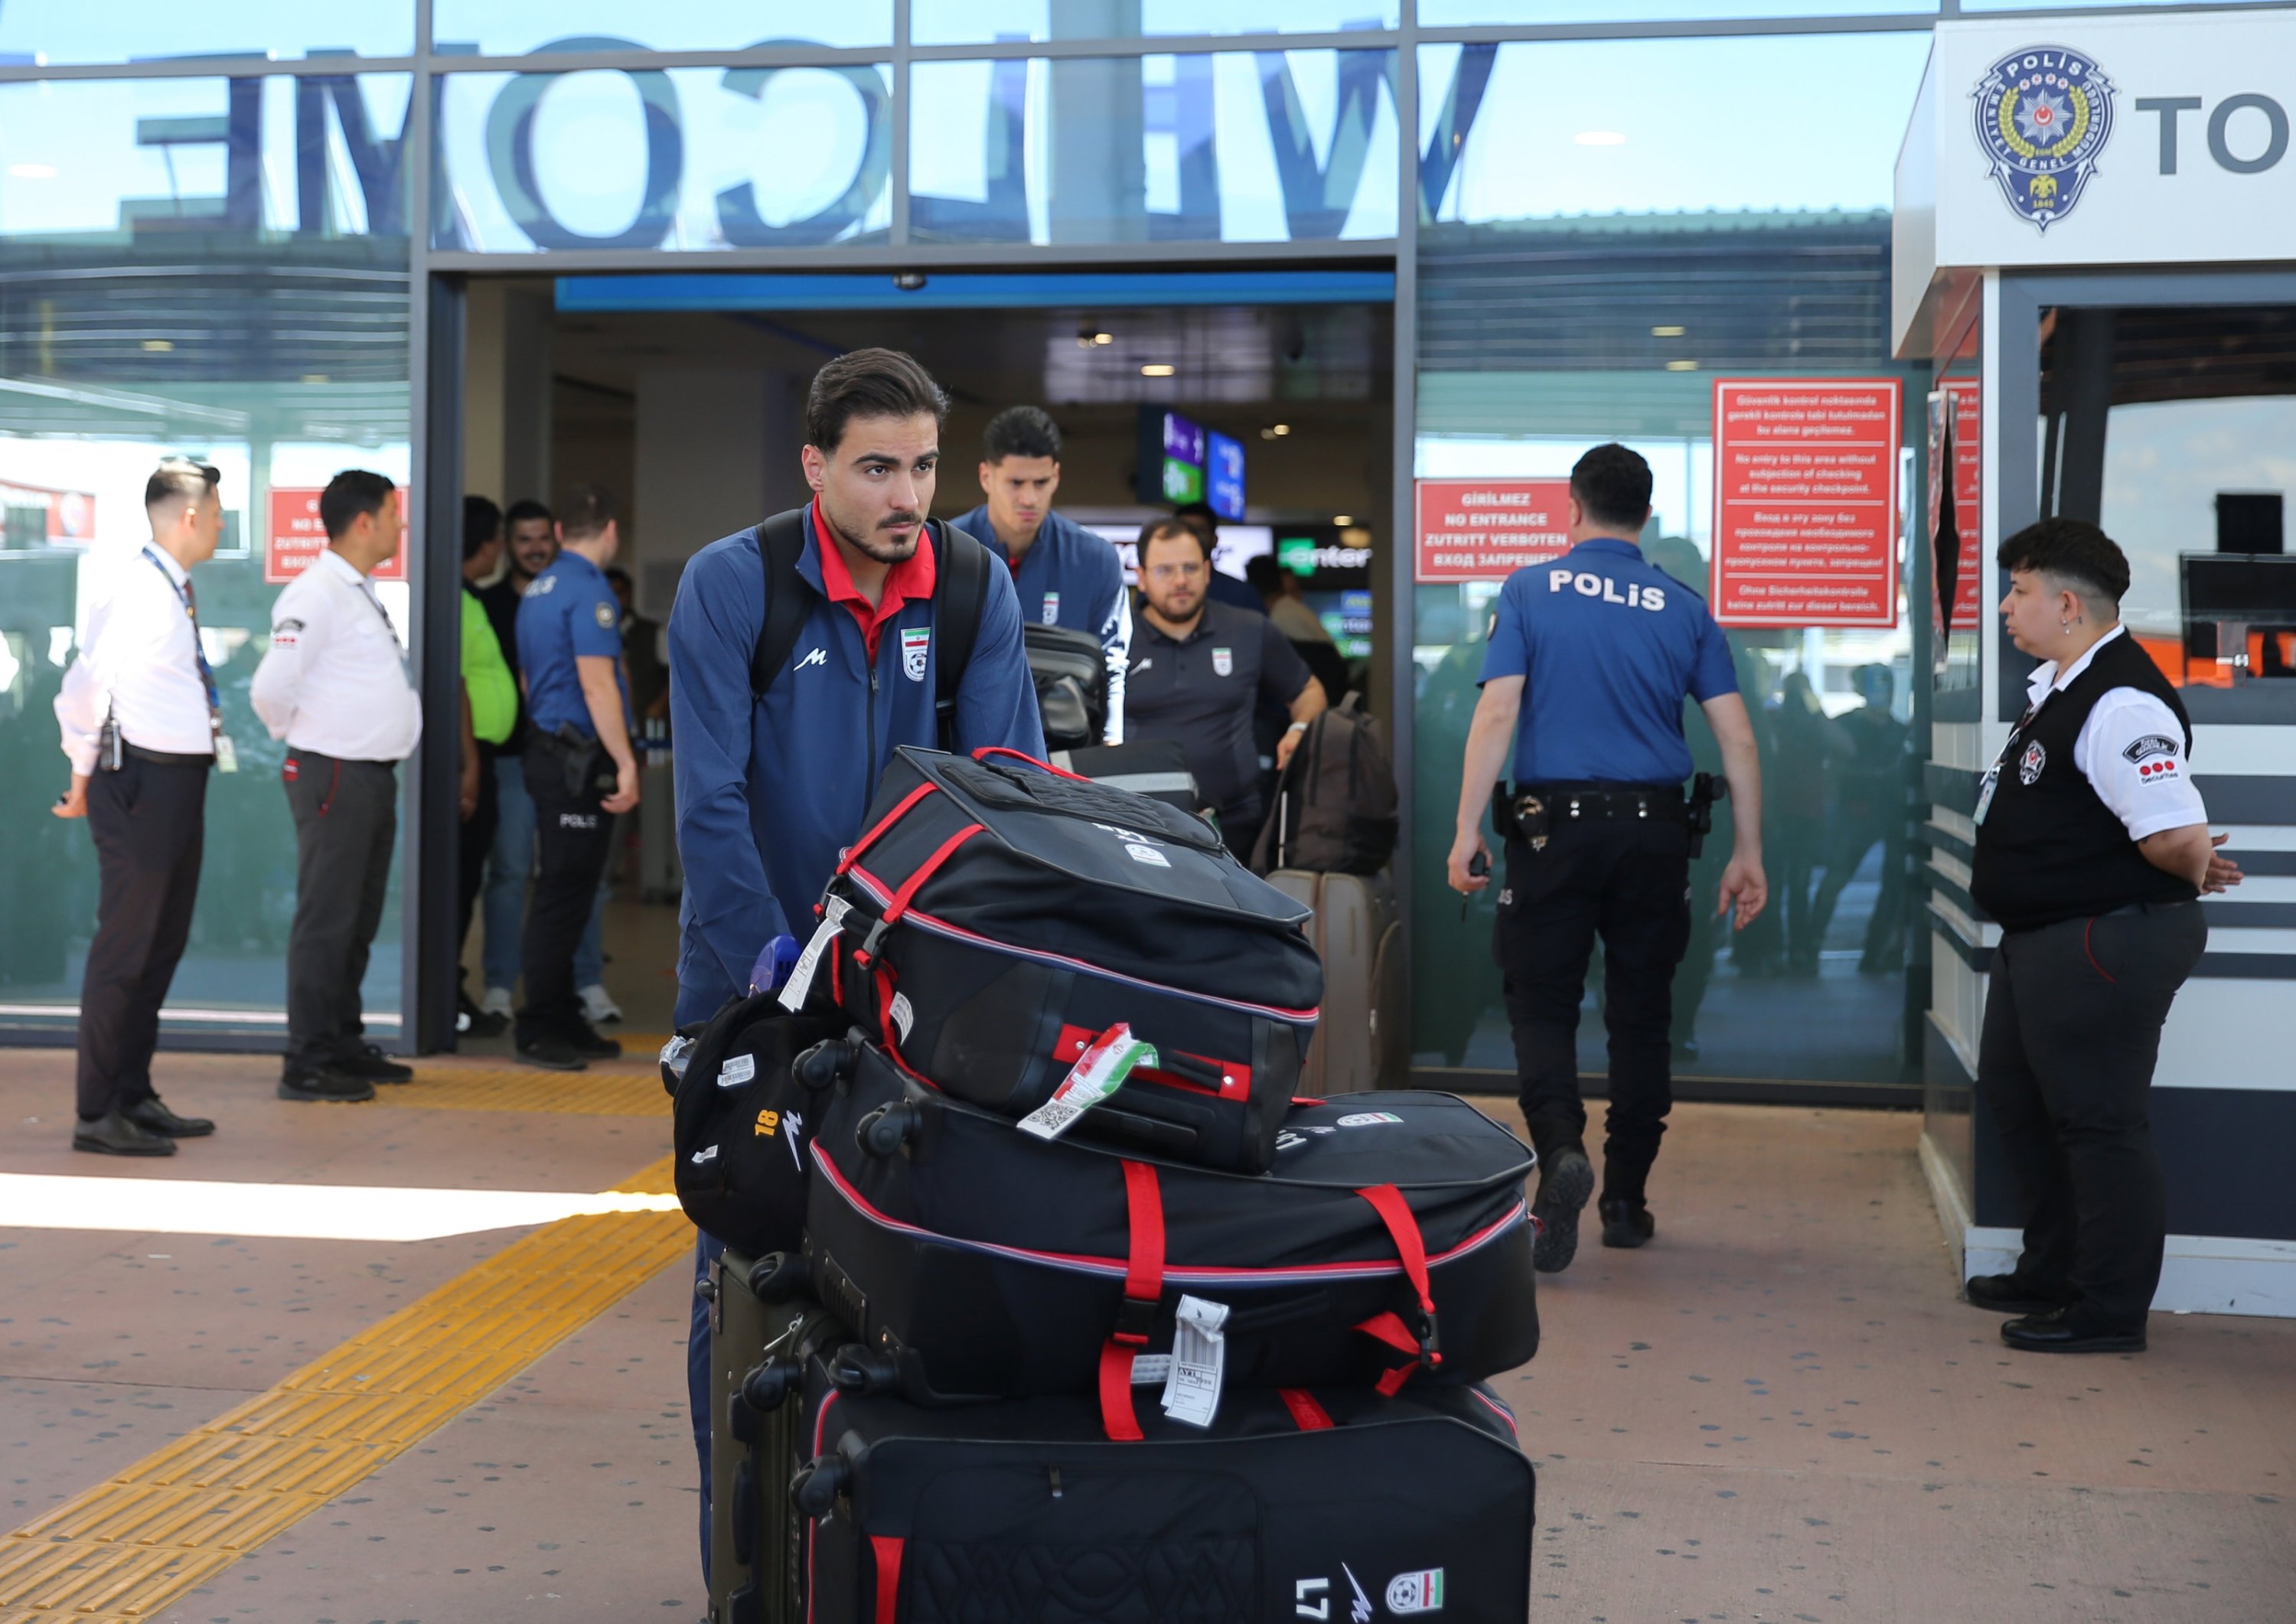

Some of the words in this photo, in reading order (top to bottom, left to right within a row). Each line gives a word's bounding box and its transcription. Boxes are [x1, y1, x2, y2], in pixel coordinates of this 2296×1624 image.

[2006, 52, 2082, 78] POLİS
[2135, 93, 2290, 175] TO
[2019, 156, 2067, 170] GENEL
[1737, 395, 1781, 406] Güvenlik
[1782, 395, 1819, 405] kontrol
[1727, 410, 1761, 422] gerekli
[1763, 410, 1805, 420] kontrole
[1807, 410, 1825, 420] tabi
[1828, 410, 1886, 420] tutulmadan
[1756, 426, 1770, 435] bu
[1773, 425, 1800, 435] alana
[1735, 455, 1750, 463] No
[1752, 455, 1778, 465] entry
[1780, 455, 1790, 464] to
[1792, 454, 1812, 464] this
[1838, 455, 1876, 465] without
[1749, 469, 1801, 481] subjection
[1803, 468, 1815, 479] of
[1816, 469, 1862, 481] checking
[1740, 484, 1750, 493] at
[1752, 484, 1768, 494] the
[1770, 484, 1810, 496] security
[1812, 484, 1870, 496] checkpoint.
[1462, 491, 1531, 506] GİRİLMEZ
[1445, 514, 1466, 527] NO
[1469, 514, 1548, 527] ENTRANCE
[1754, 512, 1781, 524] Вход
[1792, 515, 1808, 525] эту
[1812, 515, 1835, 525] зону
[1837, 512, 1855, 523] без
[1425, 533, 1487, 546] ZUTRITT
[1490, 533, 1567, 546] VERBOTEN
[1433, 554, 1476, 568] ВХОД
[1739, 585, 1766, 595] Ohne
[1727, 600, 1754, 610] keine
[1756, 601, 1786, 611] zutritt
[1788, 602, 1804, 611] zur
[1806, 602, 1838, 611] dieser
[755, 1109, 779, 1136] 18
[1296, 1577, 1329, 1619] L7
